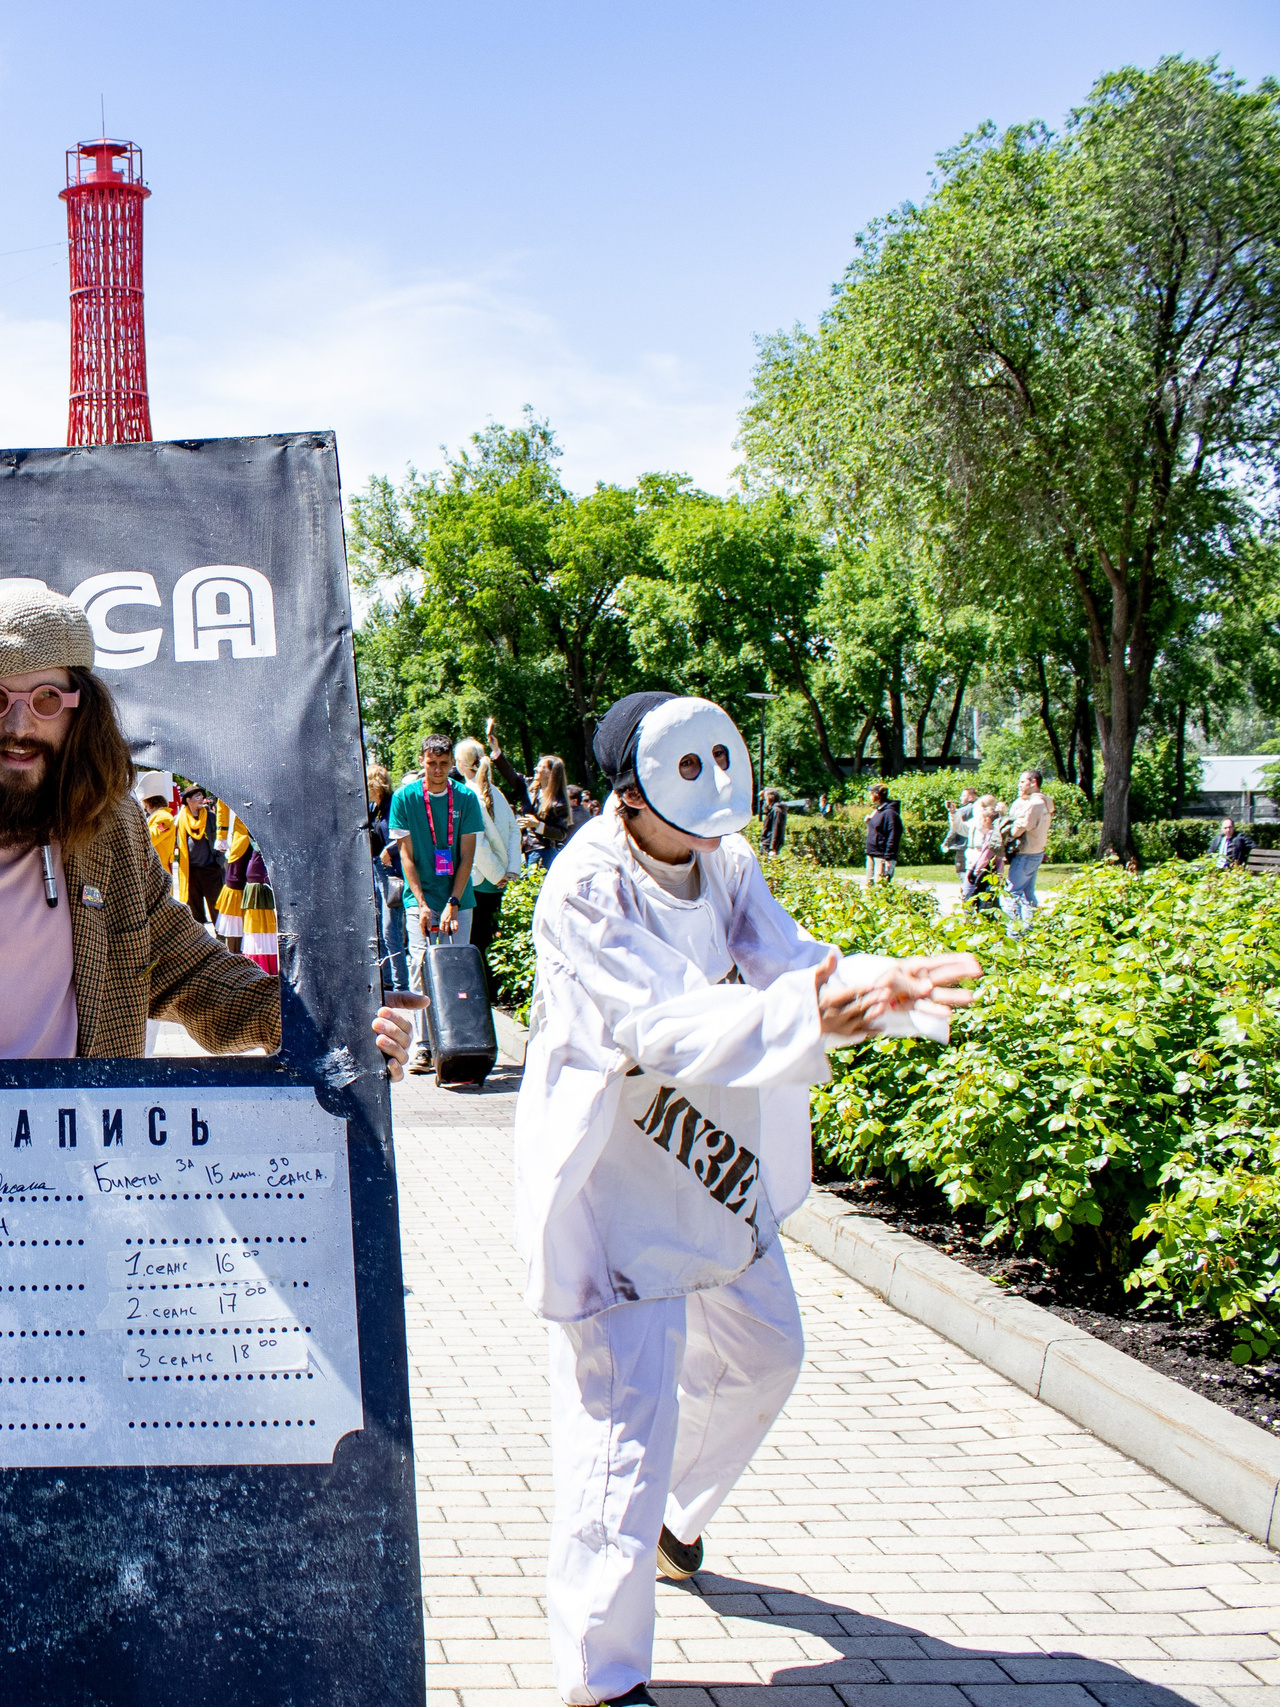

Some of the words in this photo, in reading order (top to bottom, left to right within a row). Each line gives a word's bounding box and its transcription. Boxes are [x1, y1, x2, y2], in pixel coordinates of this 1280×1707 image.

[93, 1161, 163, 1193] Билеты
[204, 1163, 224, 1186] 15
[633, 1085, 761, 1230] МУЗЕ
